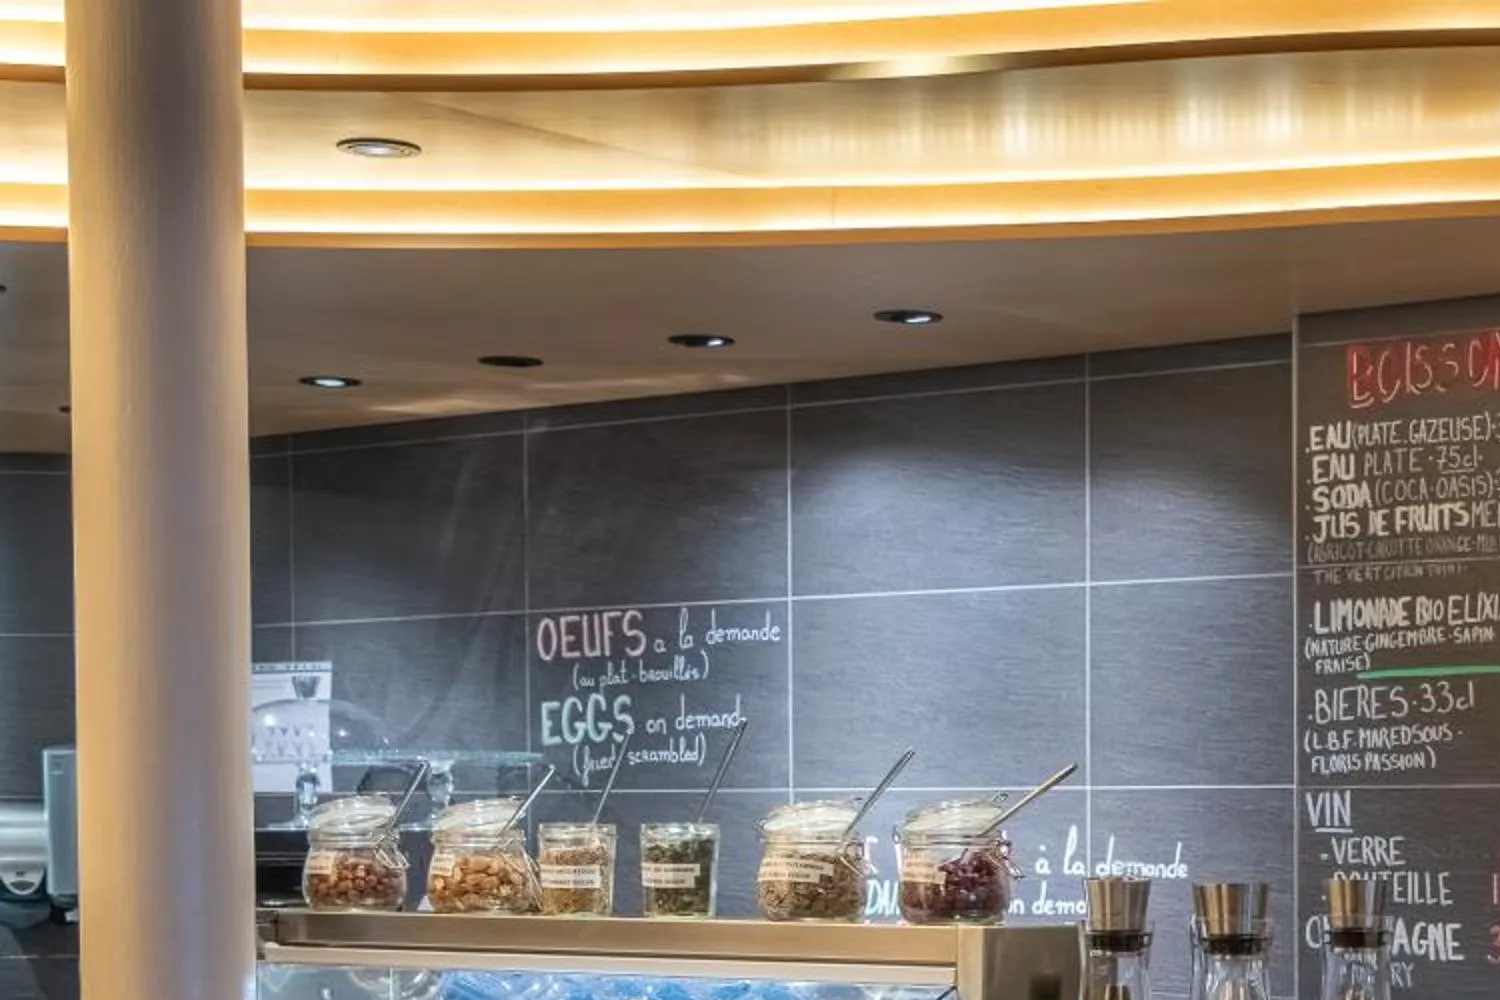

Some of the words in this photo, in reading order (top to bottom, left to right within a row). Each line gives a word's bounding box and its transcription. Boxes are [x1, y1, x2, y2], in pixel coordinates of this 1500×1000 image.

[1309, 419, 1351, 451] EAU
[1312, 451, 1356, 485] EAU
[1363, 446, 1423, 477] PLATE
[1312, 483, 1373, 512] SODA
[1312, 512, 1361, 544] JUS
[1394, 501, 1470, 534] FRUITS
[536, 609, 647, 662] OEUFS
[679, 606, 694, 650] la
[705, 607, 781, 646] demande
[1314, 596, 1412, 635] LIMONADE
[1453, 626, 1496, 644] SAPIN
[540, 694, 636, 746] EGGS
[645, 718, 667, 735] on
[675, 693, 744, 731] demand
[1314, 686, 1410, 725] BIERES
[1358, 723, 1454, 748] MAREDSOUS
[1311, 754, 1362, 779] FLORIS
[1306, 791, 1352, 829] VIN
[1035, 843, 1052, 875] à
[1063, 825, 1086, 876] la
[1095, 833, 1190, 879] demande
[1331, 835, 1406, 866] VERRE
